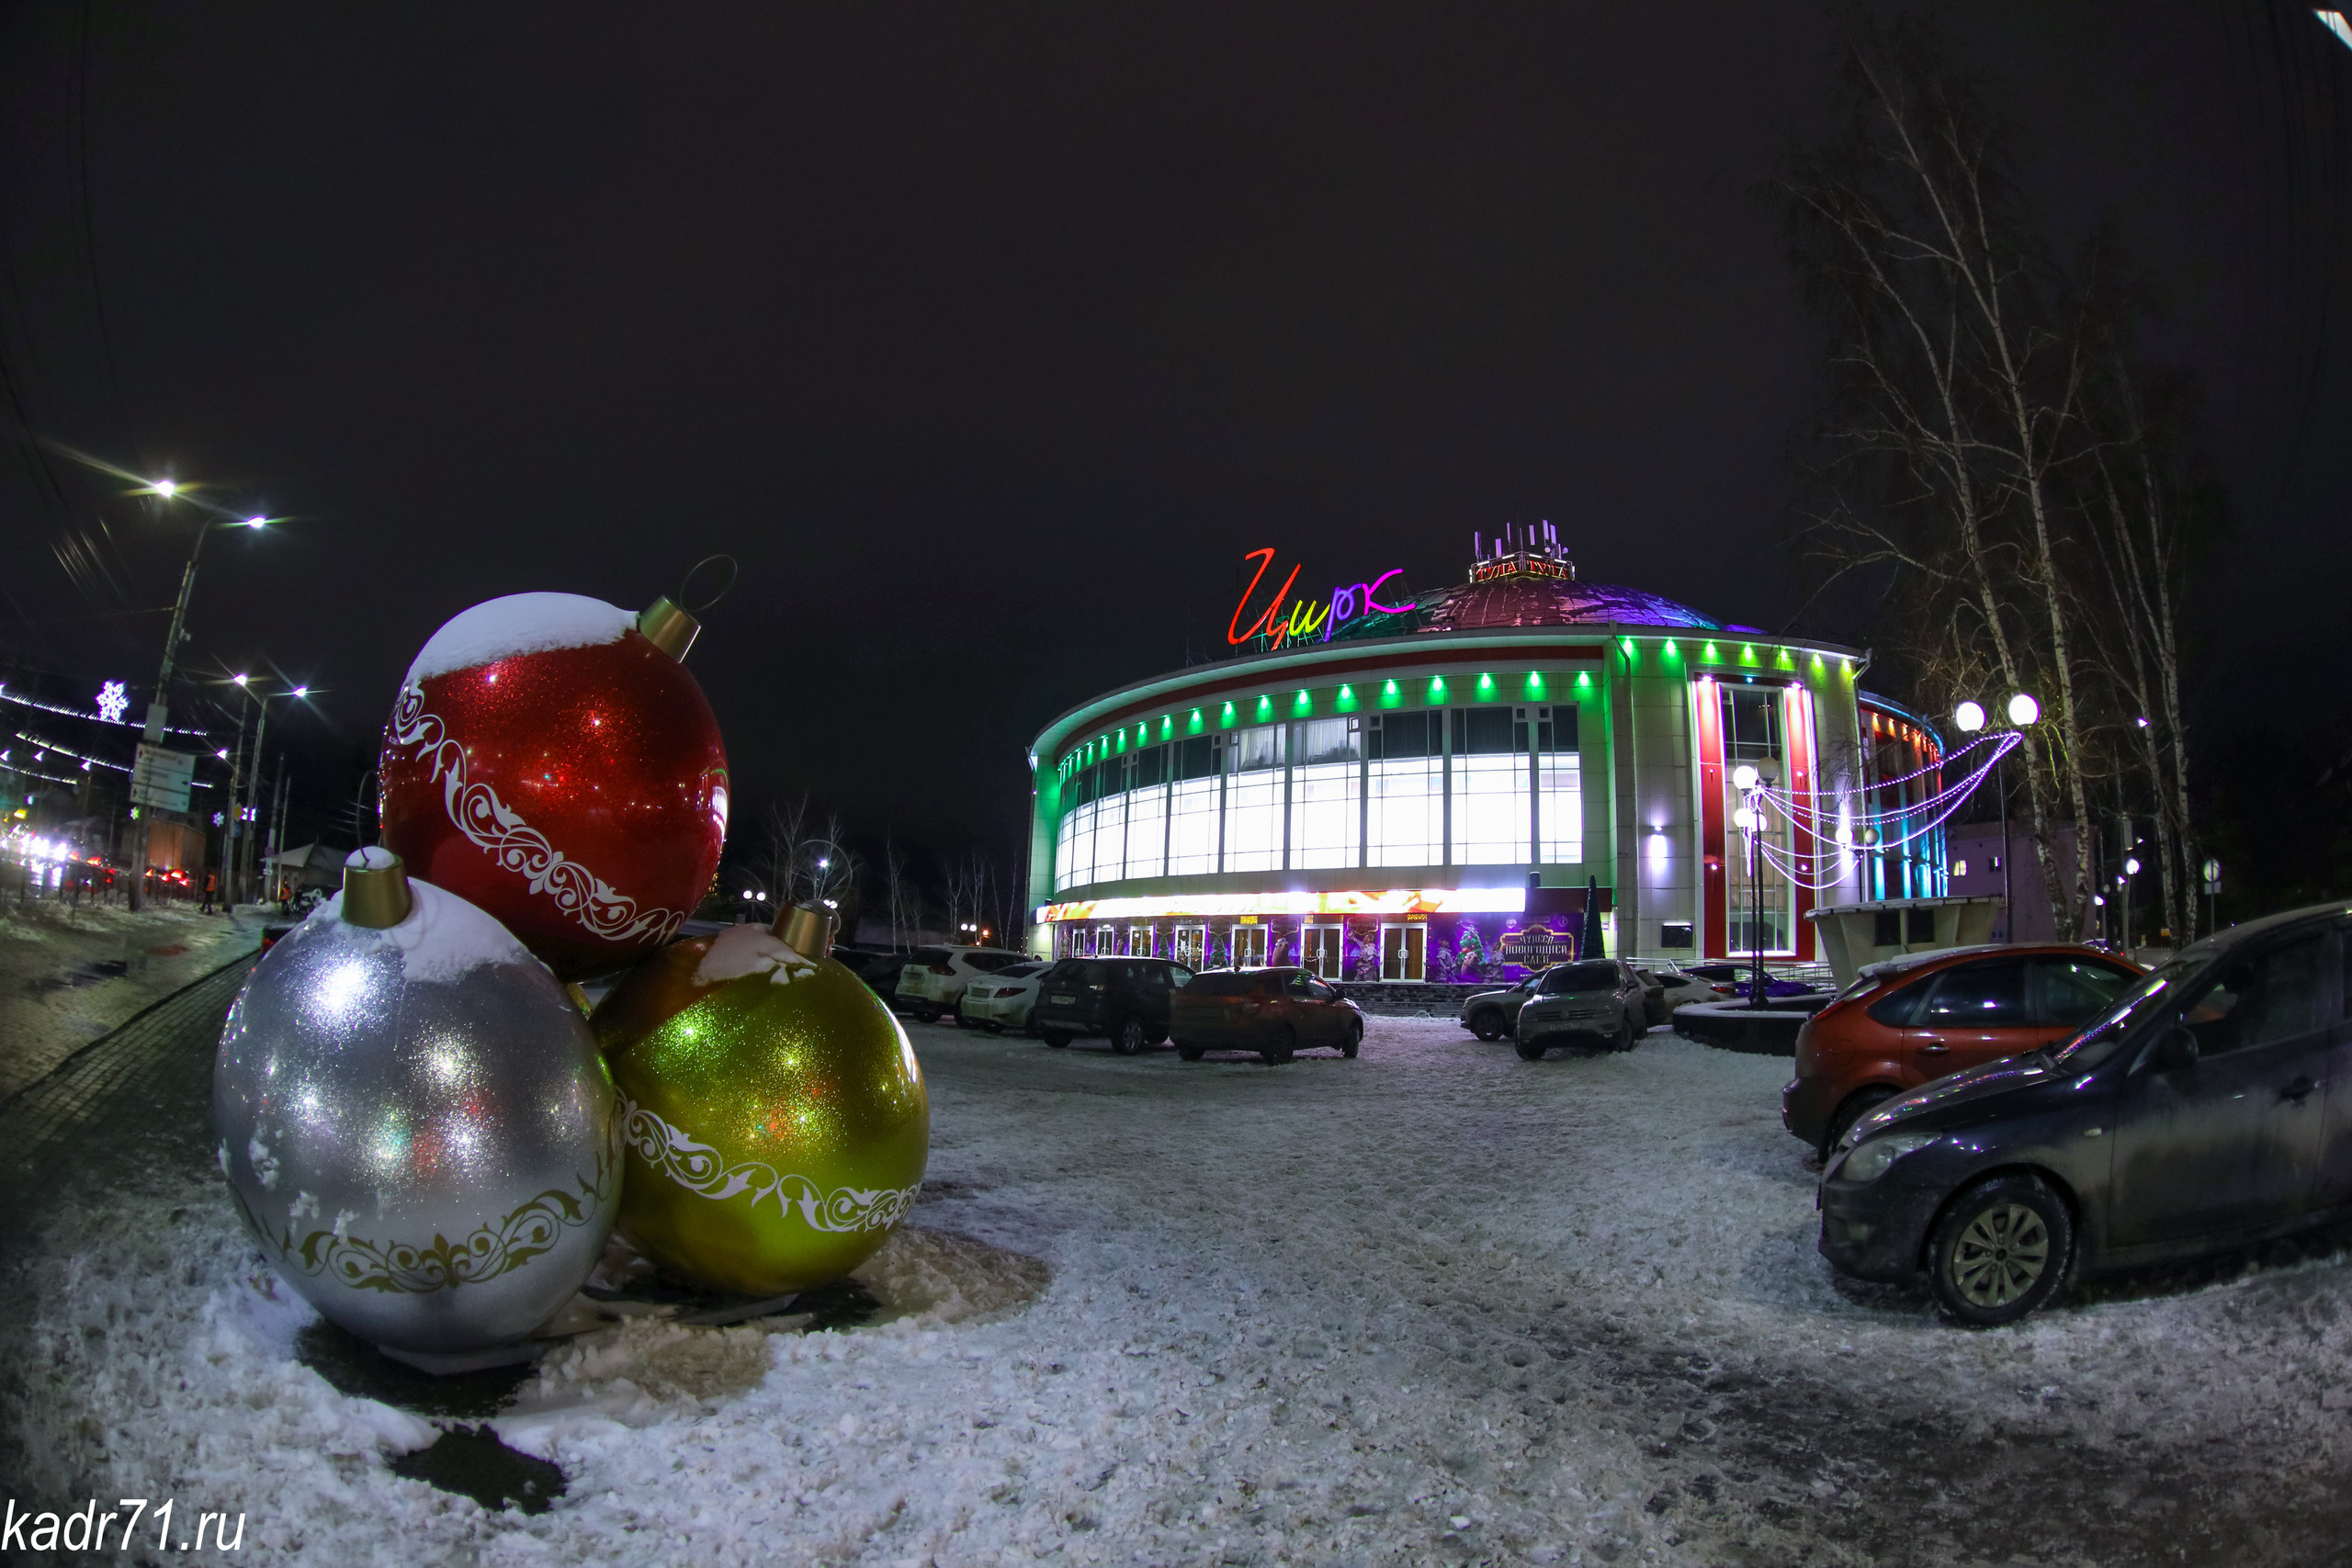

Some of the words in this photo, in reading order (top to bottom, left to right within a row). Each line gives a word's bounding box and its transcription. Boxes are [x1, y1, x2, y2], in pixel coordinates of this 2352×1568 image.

[1476, 561, 1518, 581] ТУЛА
[1526, 559, 1569, 579] ТУЛА
[1227, 547, 1417, 651] Цирк
[1505, 944, 1567, 955] НОВОГОДНЕЙ
